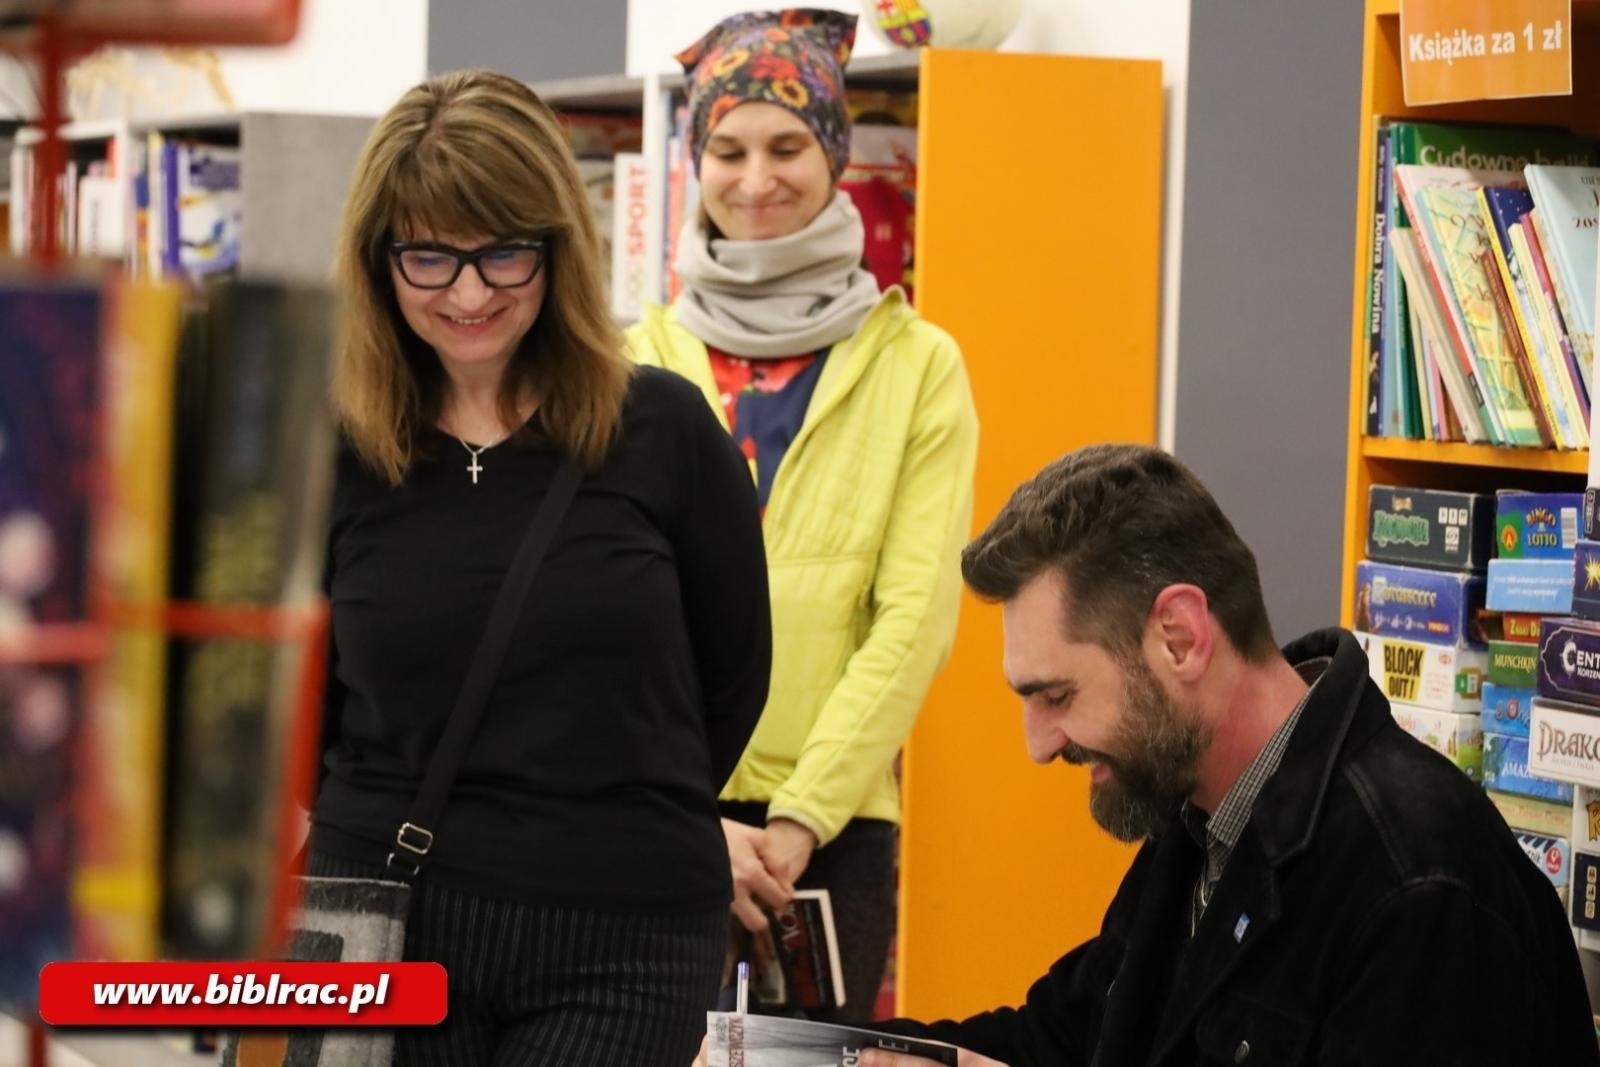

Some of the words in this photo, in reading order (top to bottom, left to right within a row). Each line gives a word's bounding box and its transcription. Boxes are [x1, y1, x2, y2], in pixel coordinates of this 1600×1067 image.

[1408, 30, 1486, 65] Książka
[1491, 31, 1516, 54] za
[1523, 22, 1534, 51] 1
[1543, 20, 1563, 49] zł
[626, 166, 647, 256] SPORT
[1374, 213, 1386, 263] Dobra
[1371, 269, 1385, 333] Nowina
[1527, 533, 1558, 547] LOTTO
[1384, 645, 1423, 677] BLOCK
[1494, 653, 1537, 673] MUNCHKIN
